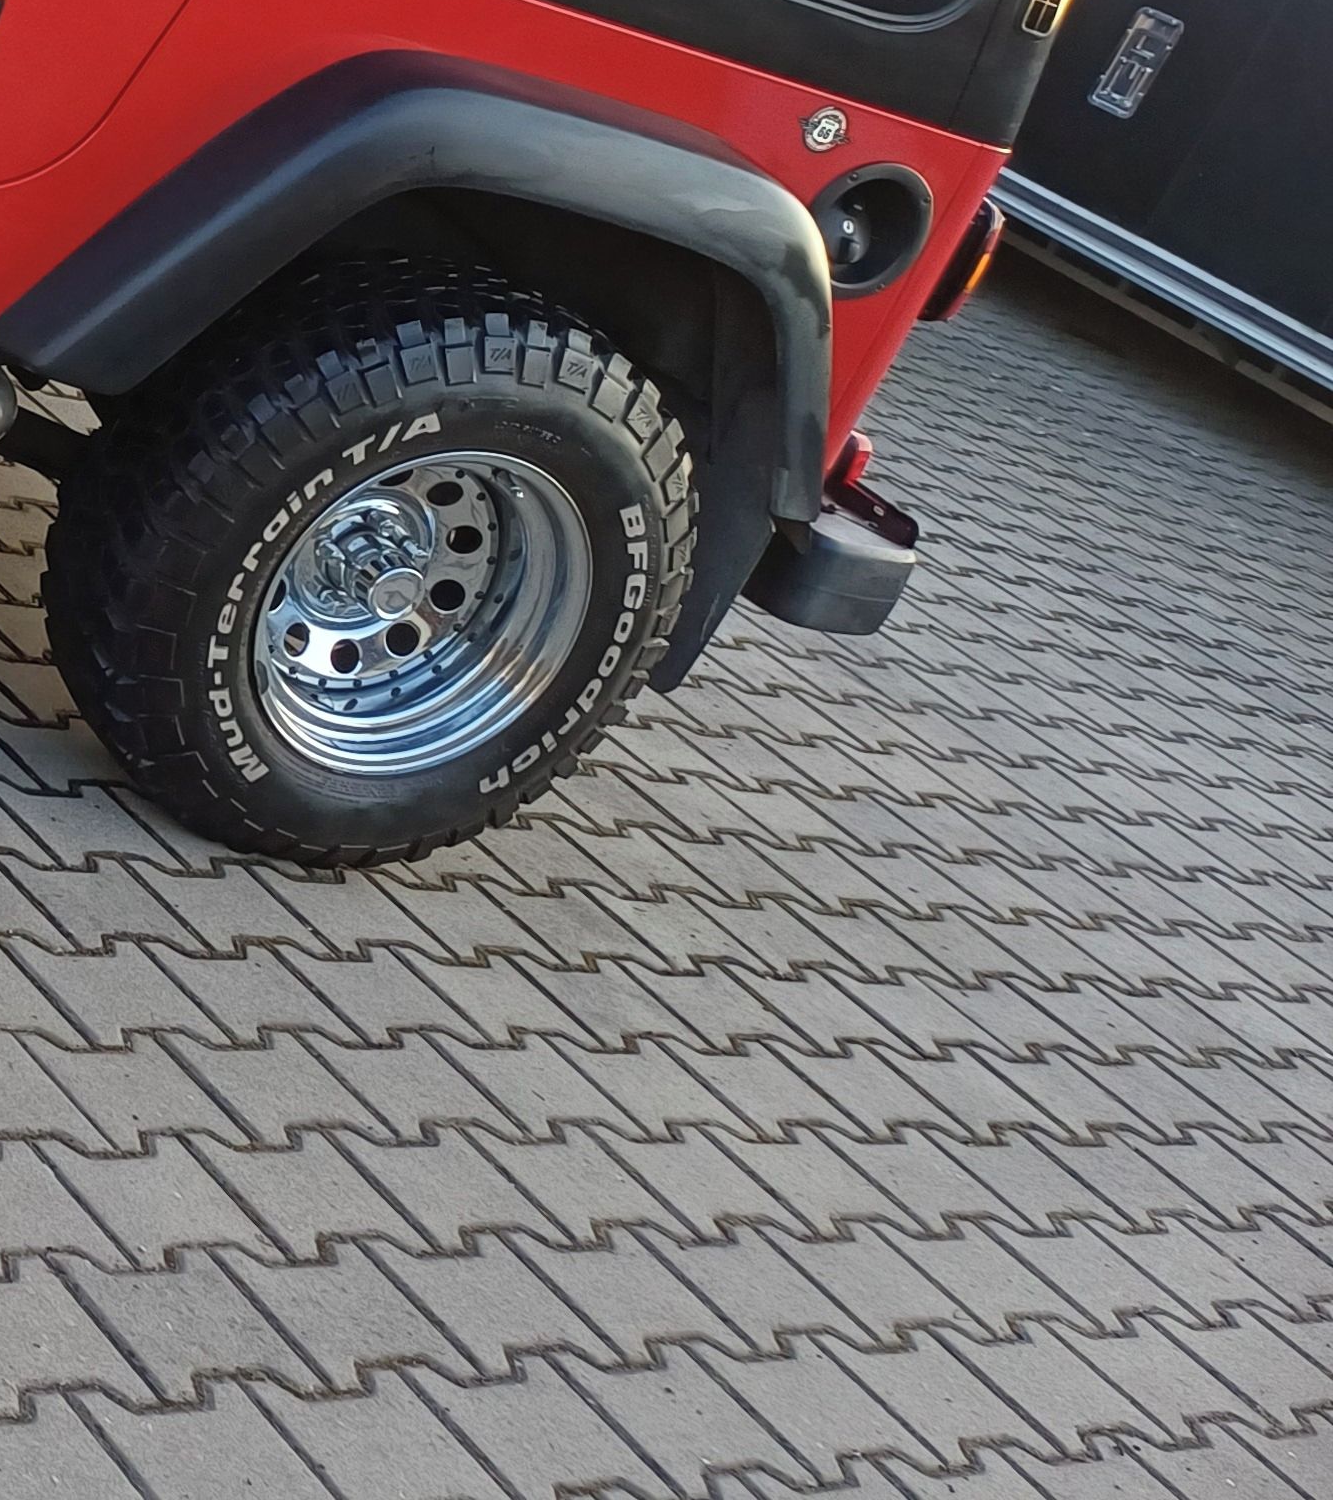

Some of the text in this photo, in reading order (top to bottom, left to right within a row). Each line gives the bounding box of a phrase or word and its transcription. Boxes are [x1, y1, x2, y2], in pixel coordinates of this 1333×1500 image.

[817, 126, 833, 140] 66
[206, 411, 443, 784] Mud-Terrain T/A
[478, 503, 650, 795] BFGoodrich
